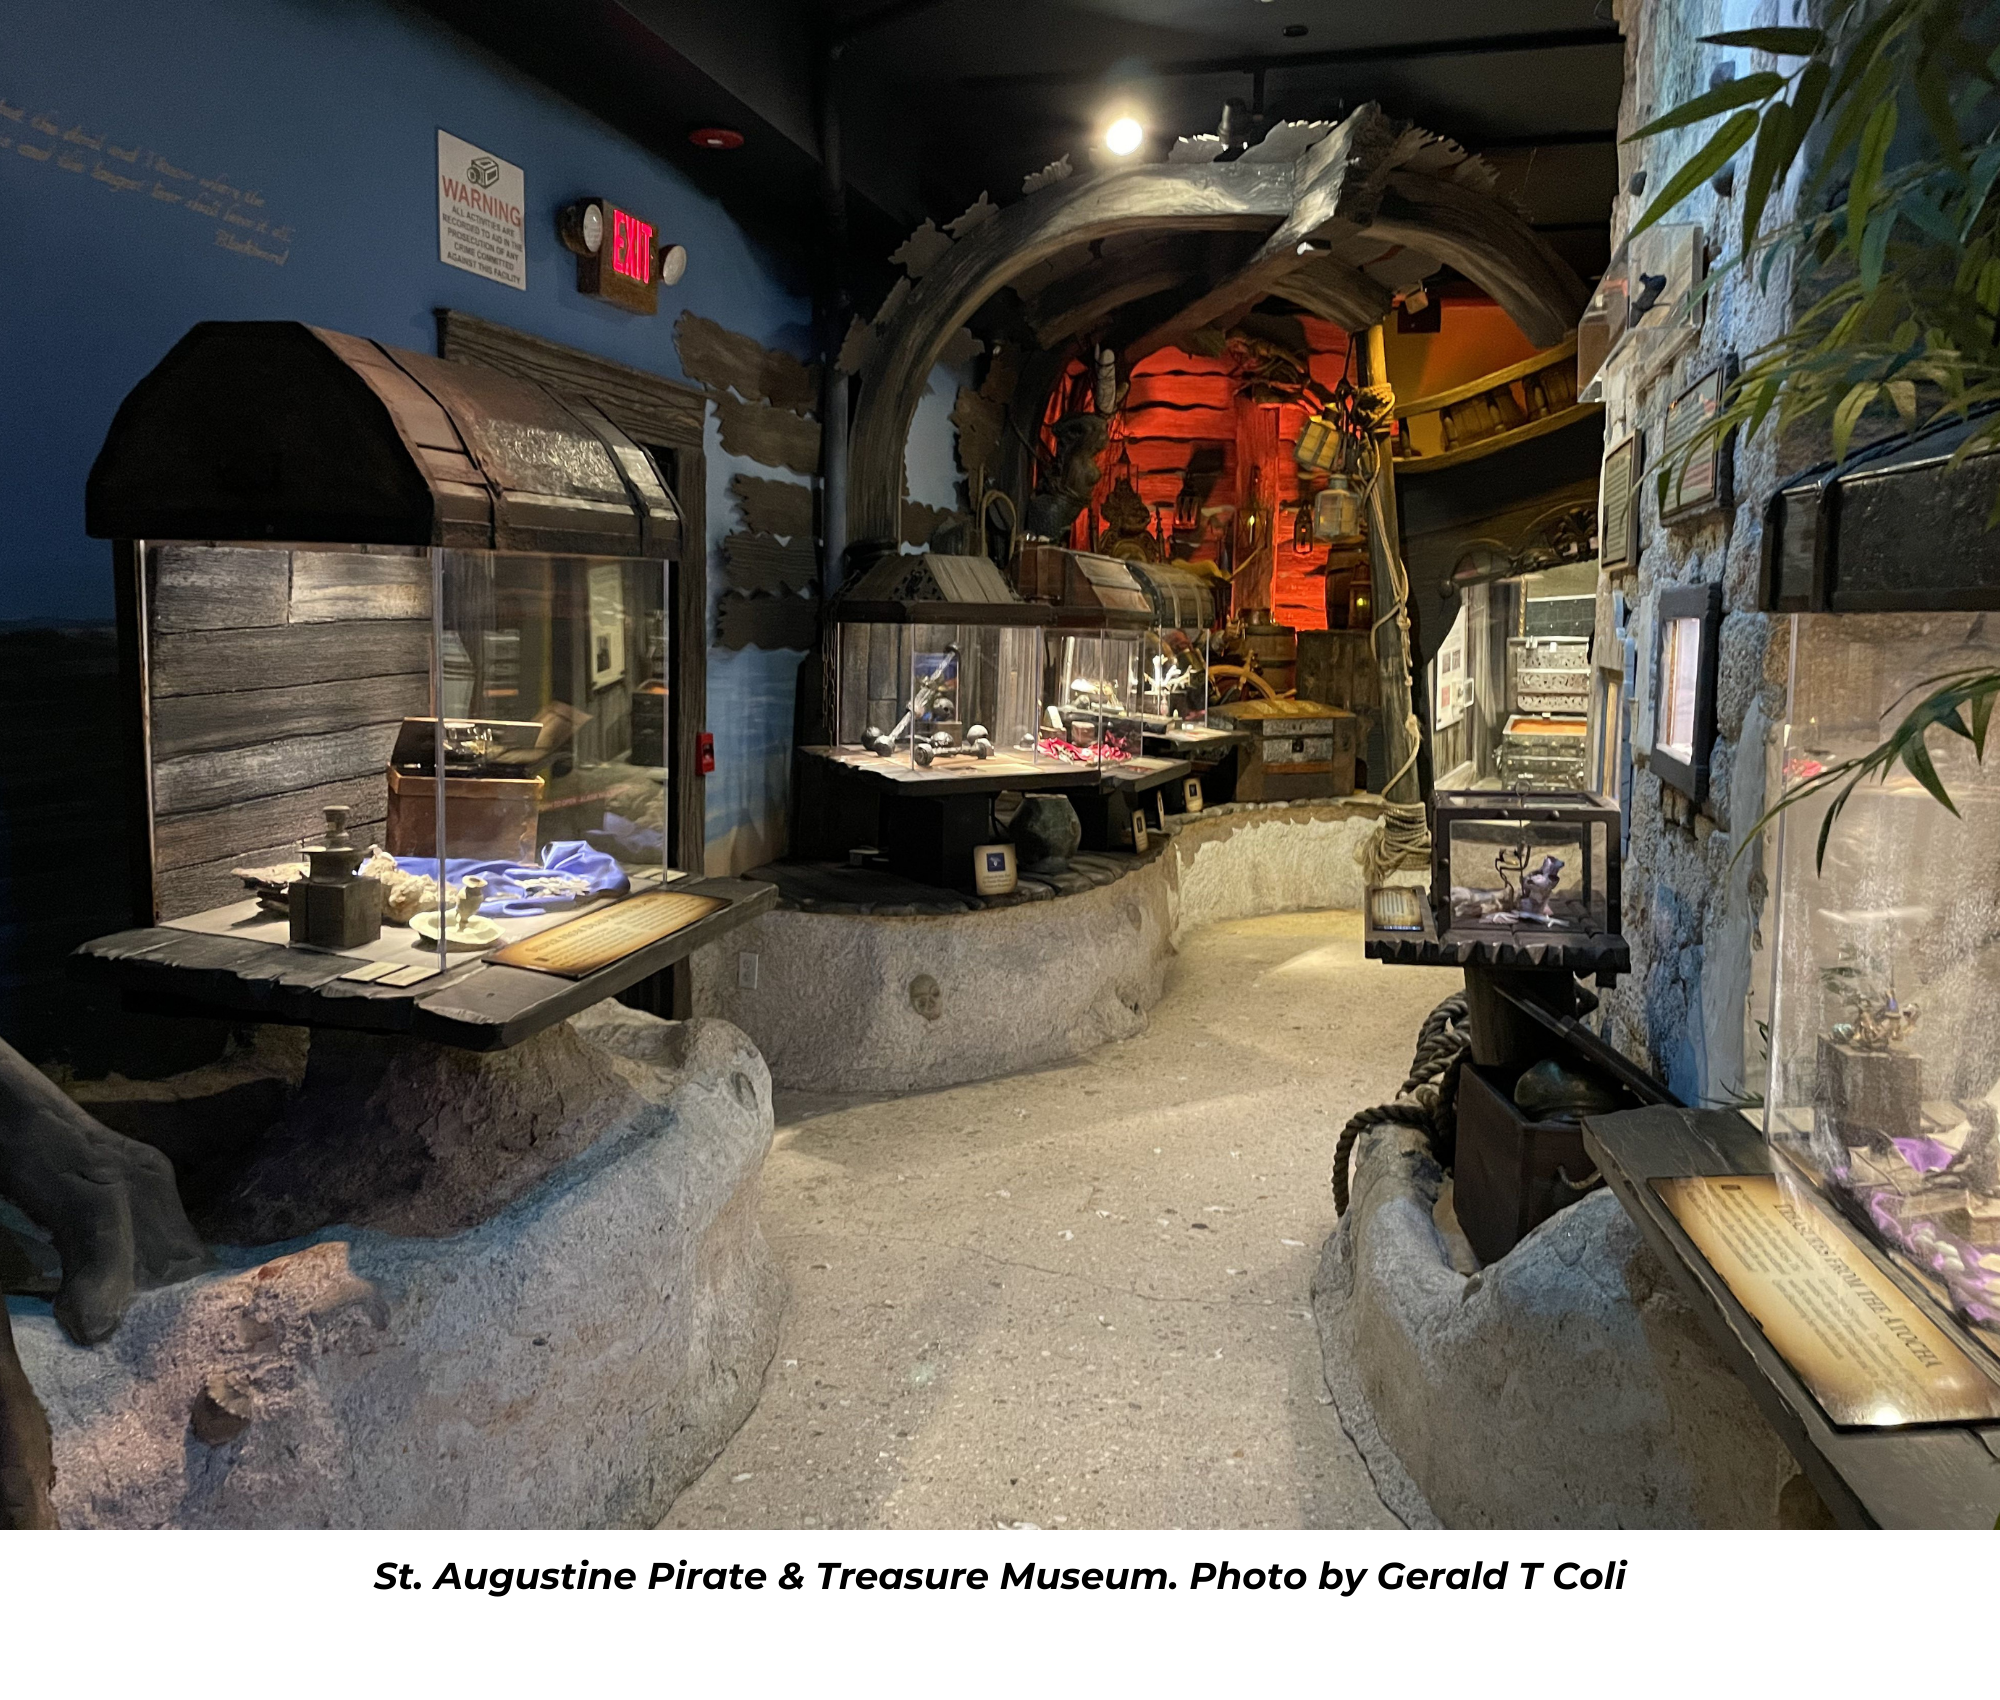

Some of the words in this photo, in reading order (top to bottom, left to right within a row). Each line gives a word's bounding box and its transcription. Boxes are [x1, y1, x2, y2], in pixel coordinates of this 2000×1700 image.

[442, 174, 522, 228] WARNING
[442, 213, 480, 235] RECORDED
[481, 228, 491, 239] TO
[492, 233, 503, 245] AID
[504, 238, 510, 248] IN
[511, 241, 523, 253] THE
[452, 206, 465, 217] ALL
[466, 211, 501, 231] ACTIVITIES
[502, 226, 516, 238] ARE
[447, 227, 495, 253] PROSECUTION
[496, 245, 505, 256] OF
[506, 250, 519, 261] ANY
[454, 242, 476, 257] CRIME
[476, 250, 514, 271] COMMITTED
[613, 209, 653, 284] EXIT
[447, 251, 477, 269] AGAINST
[477, 261, 493, 275] THIS
[494, 267, 521, 284] FACILITY
[1824, 1252, 1868, 1289] FROM
[1854, 1288, 1893, 1314] THE
